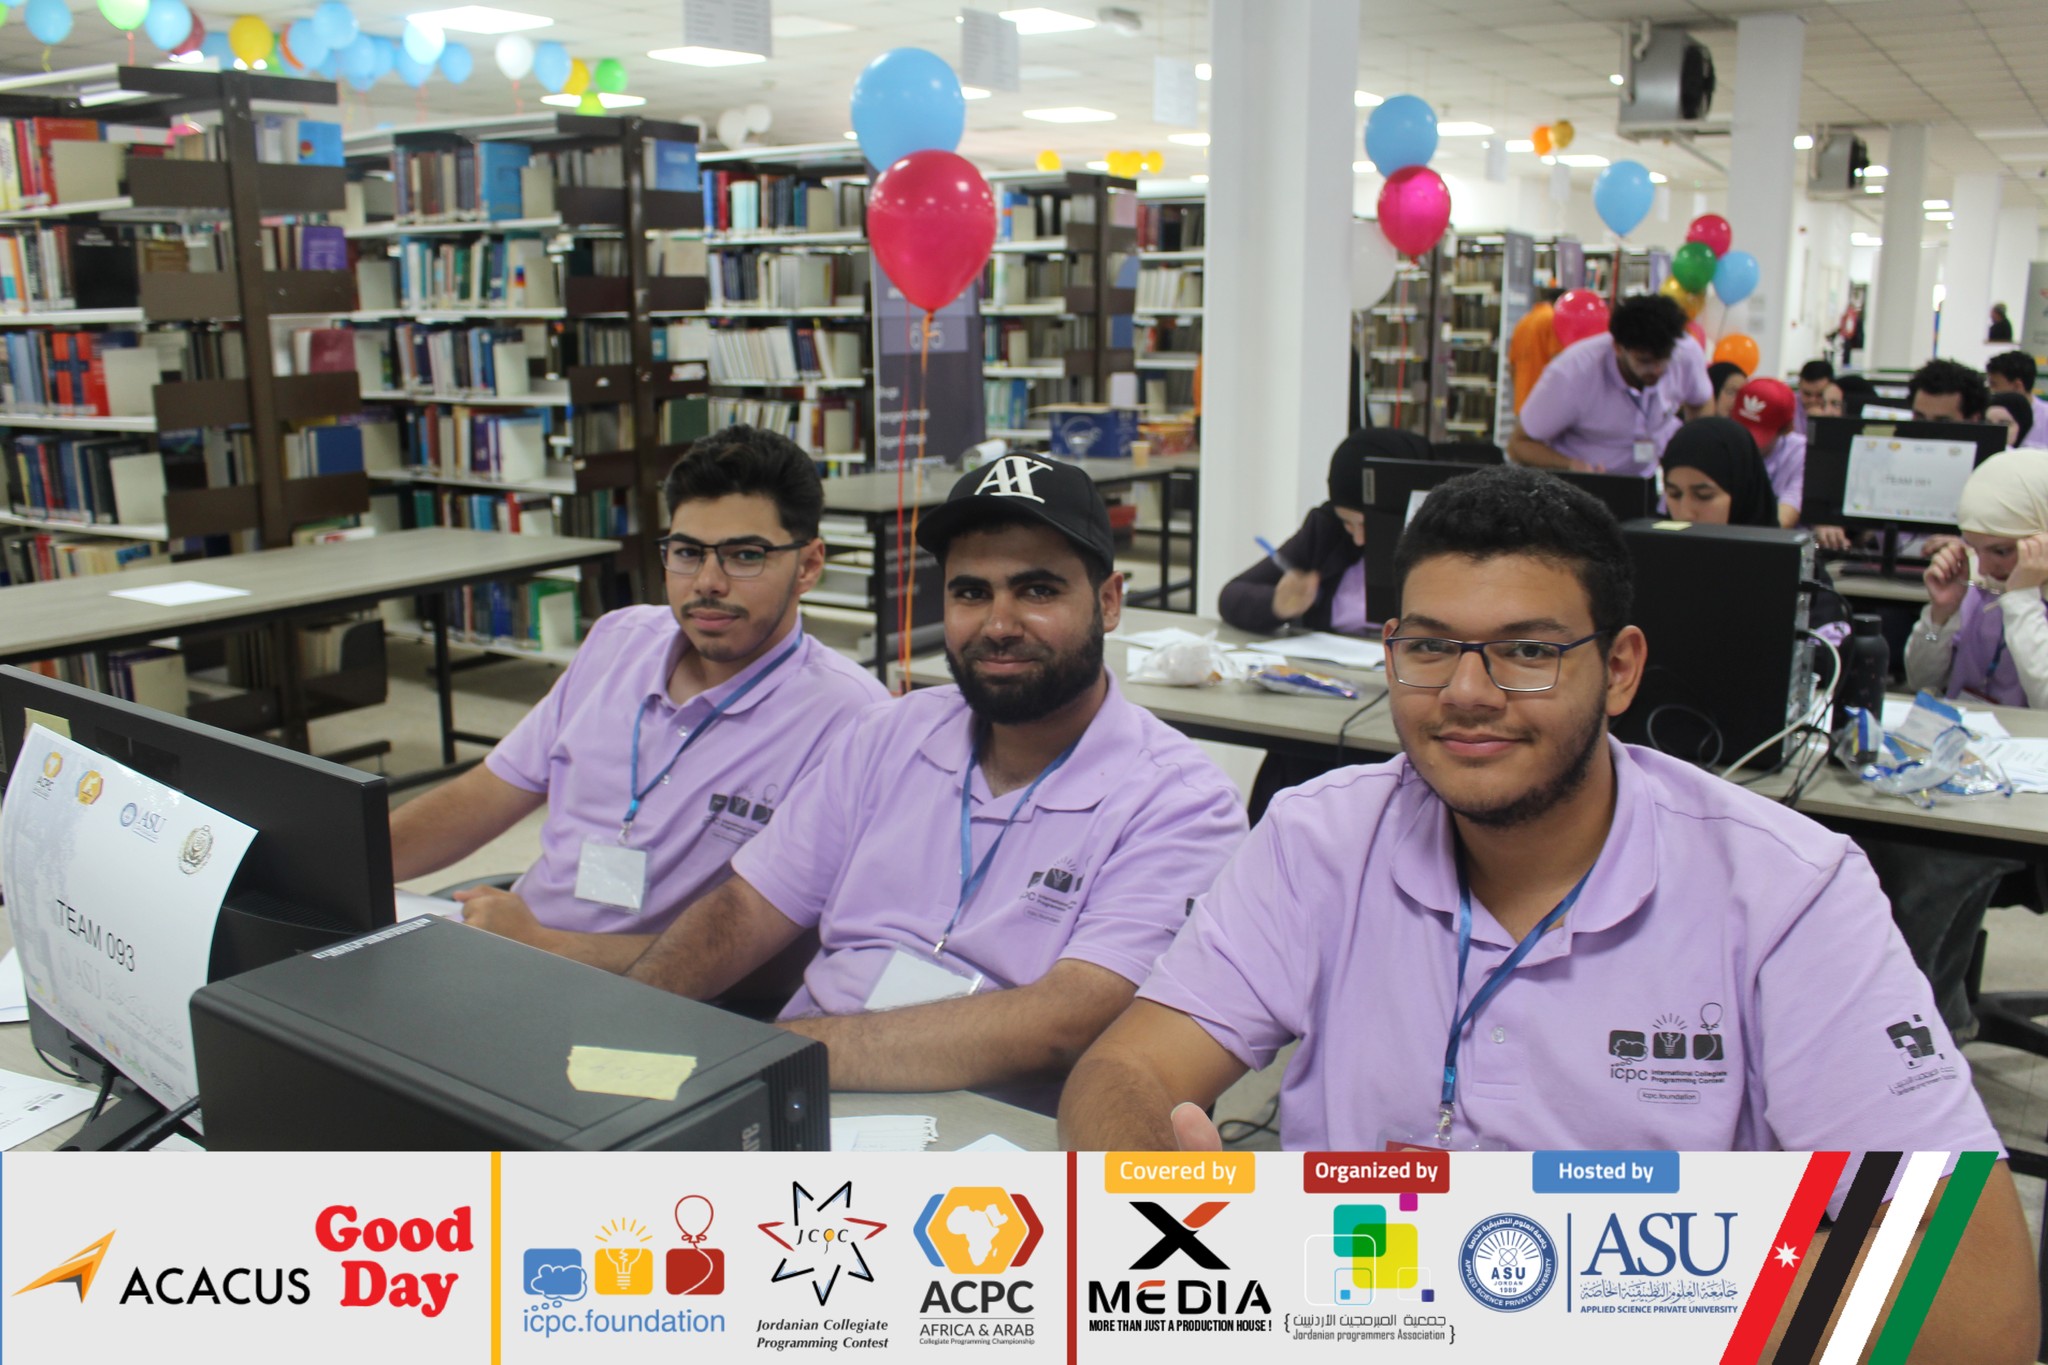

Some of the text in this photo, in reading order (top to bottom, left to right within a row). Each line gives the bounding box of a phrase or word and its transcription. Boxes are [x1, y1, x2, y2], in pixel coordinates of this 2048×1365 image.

[56, 899, 135, 972] TEAM 093
[1610, 1064, 1648, 1083] icpc
[1651, 1076, 1697, 1085] Programming
[1694, 1070, 1728, 1078] Collegiate
